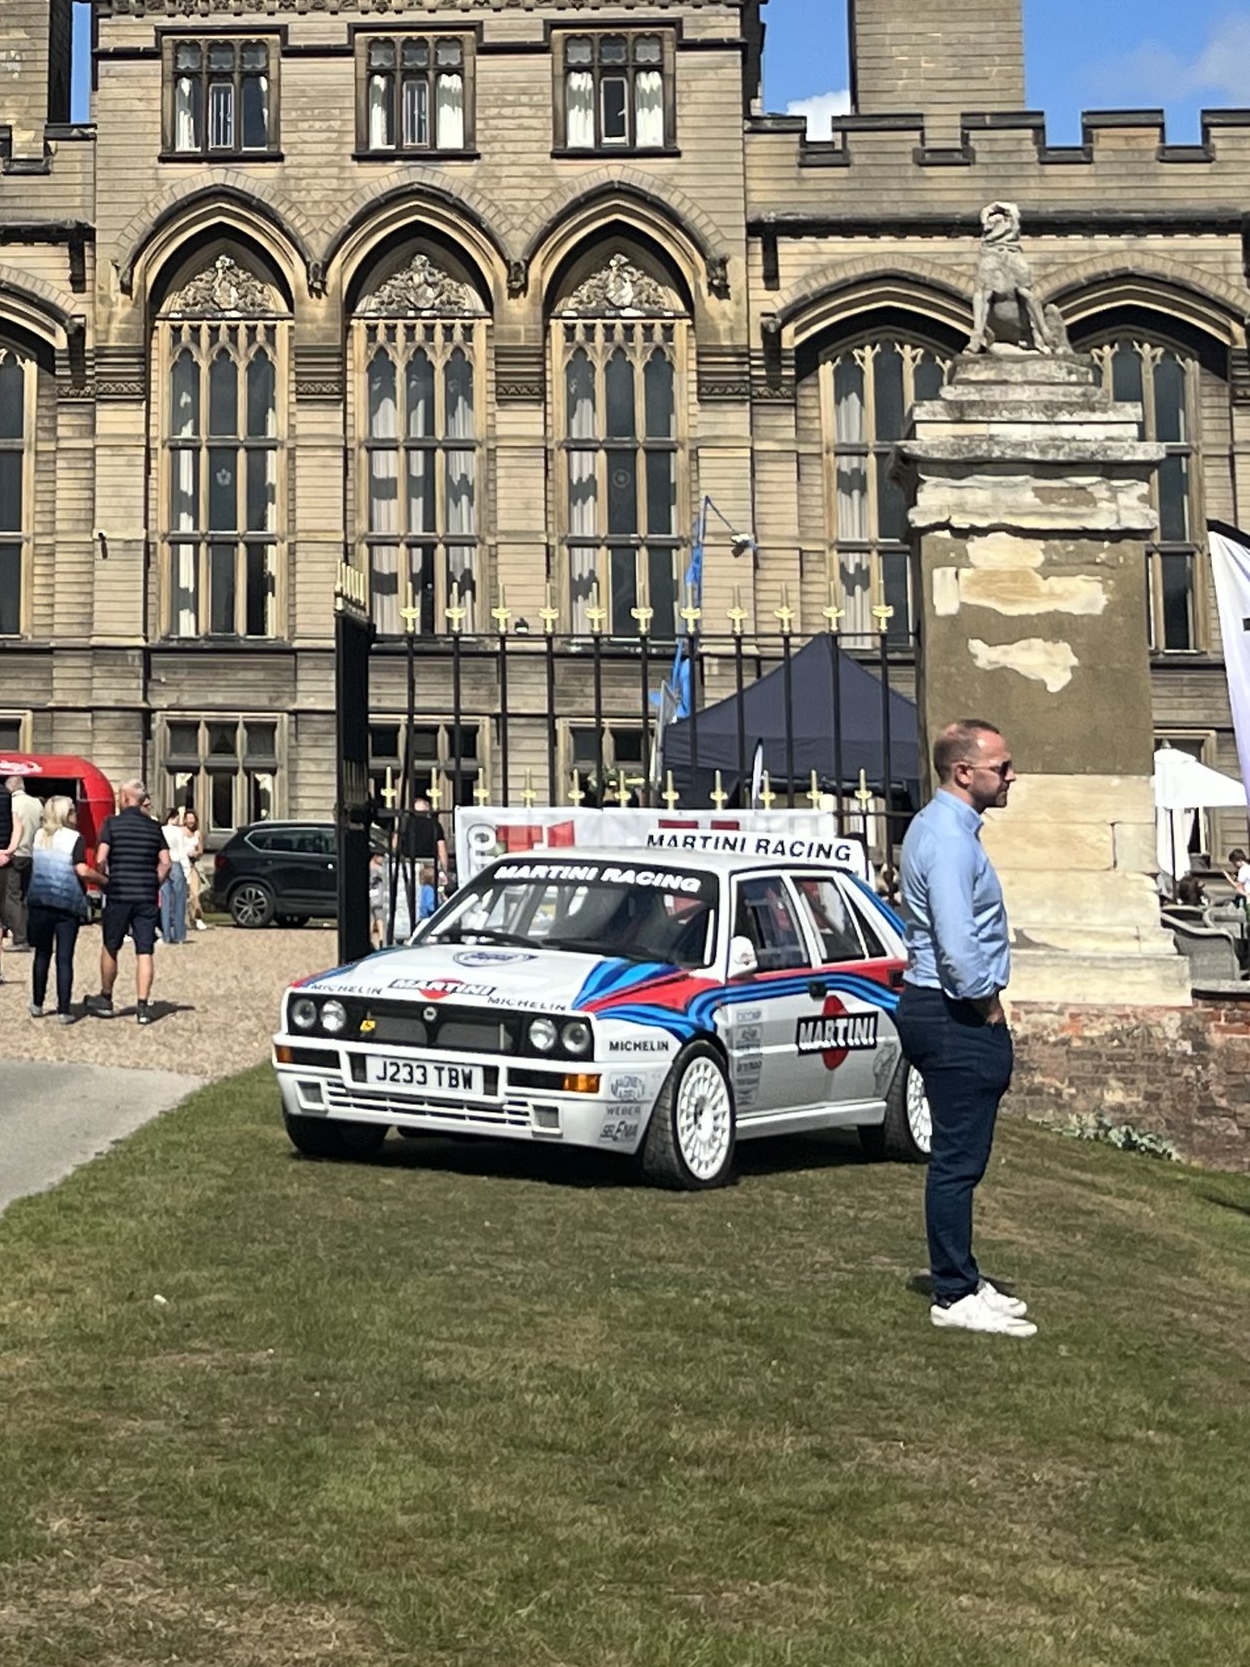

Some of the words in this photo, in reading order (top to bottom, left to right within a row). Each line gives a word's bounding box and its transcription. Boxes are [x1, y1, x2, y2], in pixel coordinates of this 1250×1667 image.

[647, 833, 746, 854] MARTINI
[755, 839, 852, 862] RACING
[493, 864, 598, 882] MARTINI
[600, 868, 702, 893] RACING
[309, 984, 384, 995] MICHELIN
[391, 978, 494, 997] MARTINI
[487, 996, 567, 1011] MICHELIN
[798, 1017, 875, 1050] MARTINI
[609, 1040, 669, 1052] MICHELIN
[376, 1060, 428, 1086] J233
[434, 1066, 474, 1090] TBW
